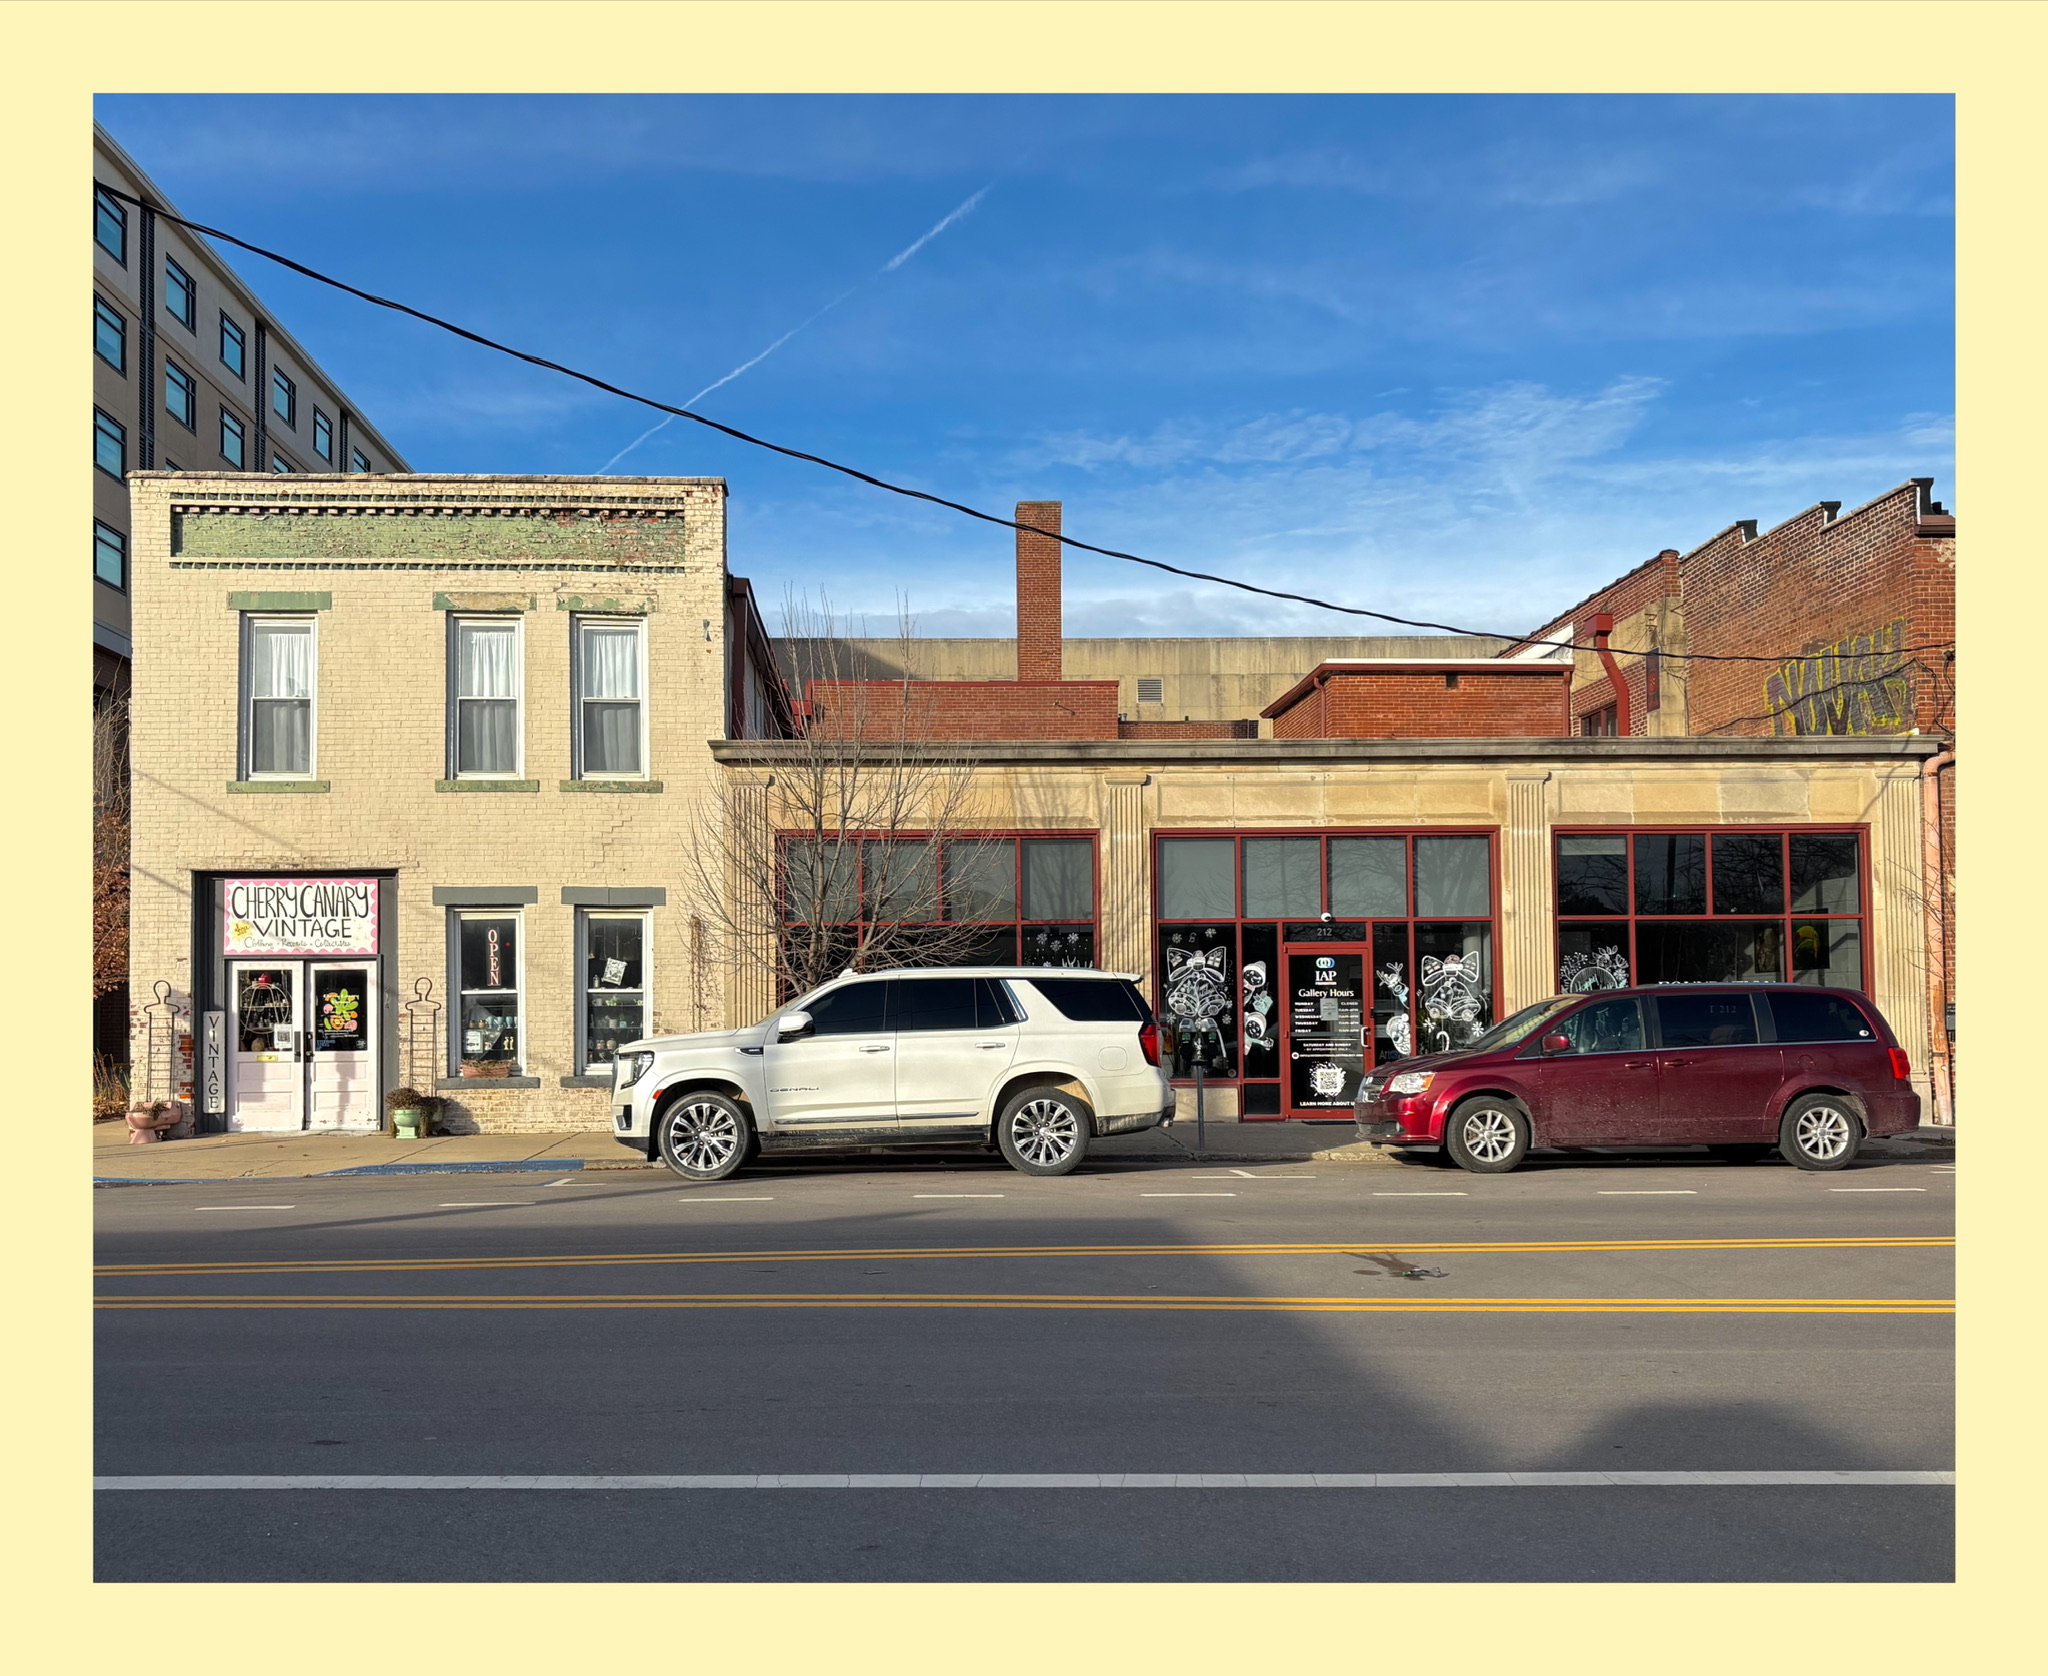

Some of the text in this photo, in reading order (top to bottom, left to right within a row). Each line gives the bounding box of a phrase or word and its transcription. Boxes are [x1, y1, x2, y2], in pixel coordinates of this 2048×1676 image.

[232, 885, 369, 919] CHERRY CANARY
[252, 918, 352, 938] VINTAGE
[1316, 928, 1332, 936] 212
[244, 936, 274, 949] Clothing
[281, 938, 307, 947] Records
[487, 929, 500, 985] OPEN
[1315, 970, 1337, 981] IAP
[1298, 988, 1354, 999] Gallery Hours
[207, 1015, 220, 1109] VINTAGE
